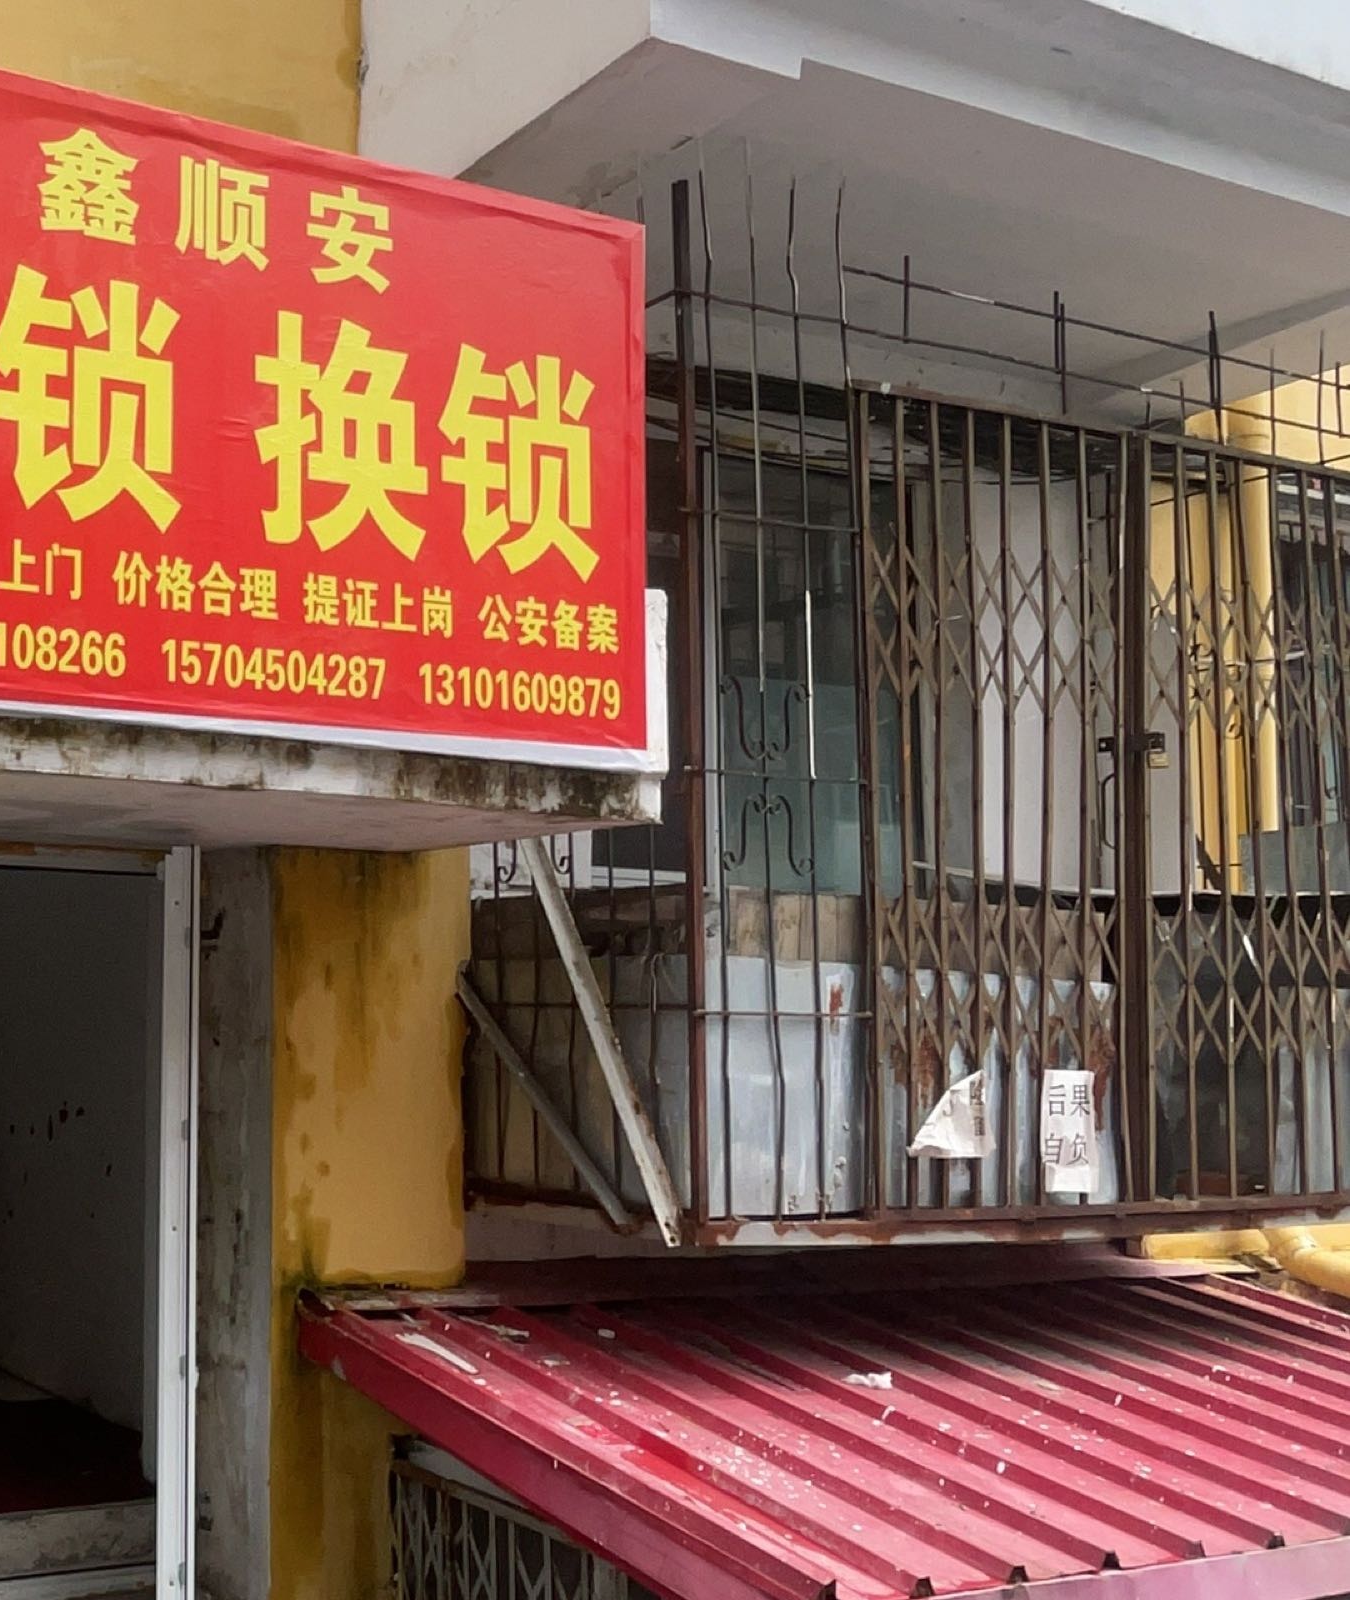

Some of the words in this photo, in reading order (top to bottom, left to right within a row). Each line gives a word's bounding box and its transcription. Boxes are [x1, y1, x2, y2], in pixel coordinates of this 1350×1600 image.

[37, 126, 395, 295] 鑫顺安
[254, 309, 600, 583] 换锁
[111, 550, 279, 620] 价格合理
[303, 572, 454, 639] 提证上岗
[477, 594, 620, 655] 公安备案
[161, 639, 387, 701] 15704504287
[419, 662, 622, 720] 13101609879
[1044, 1131, 1089, 1165] 自负
